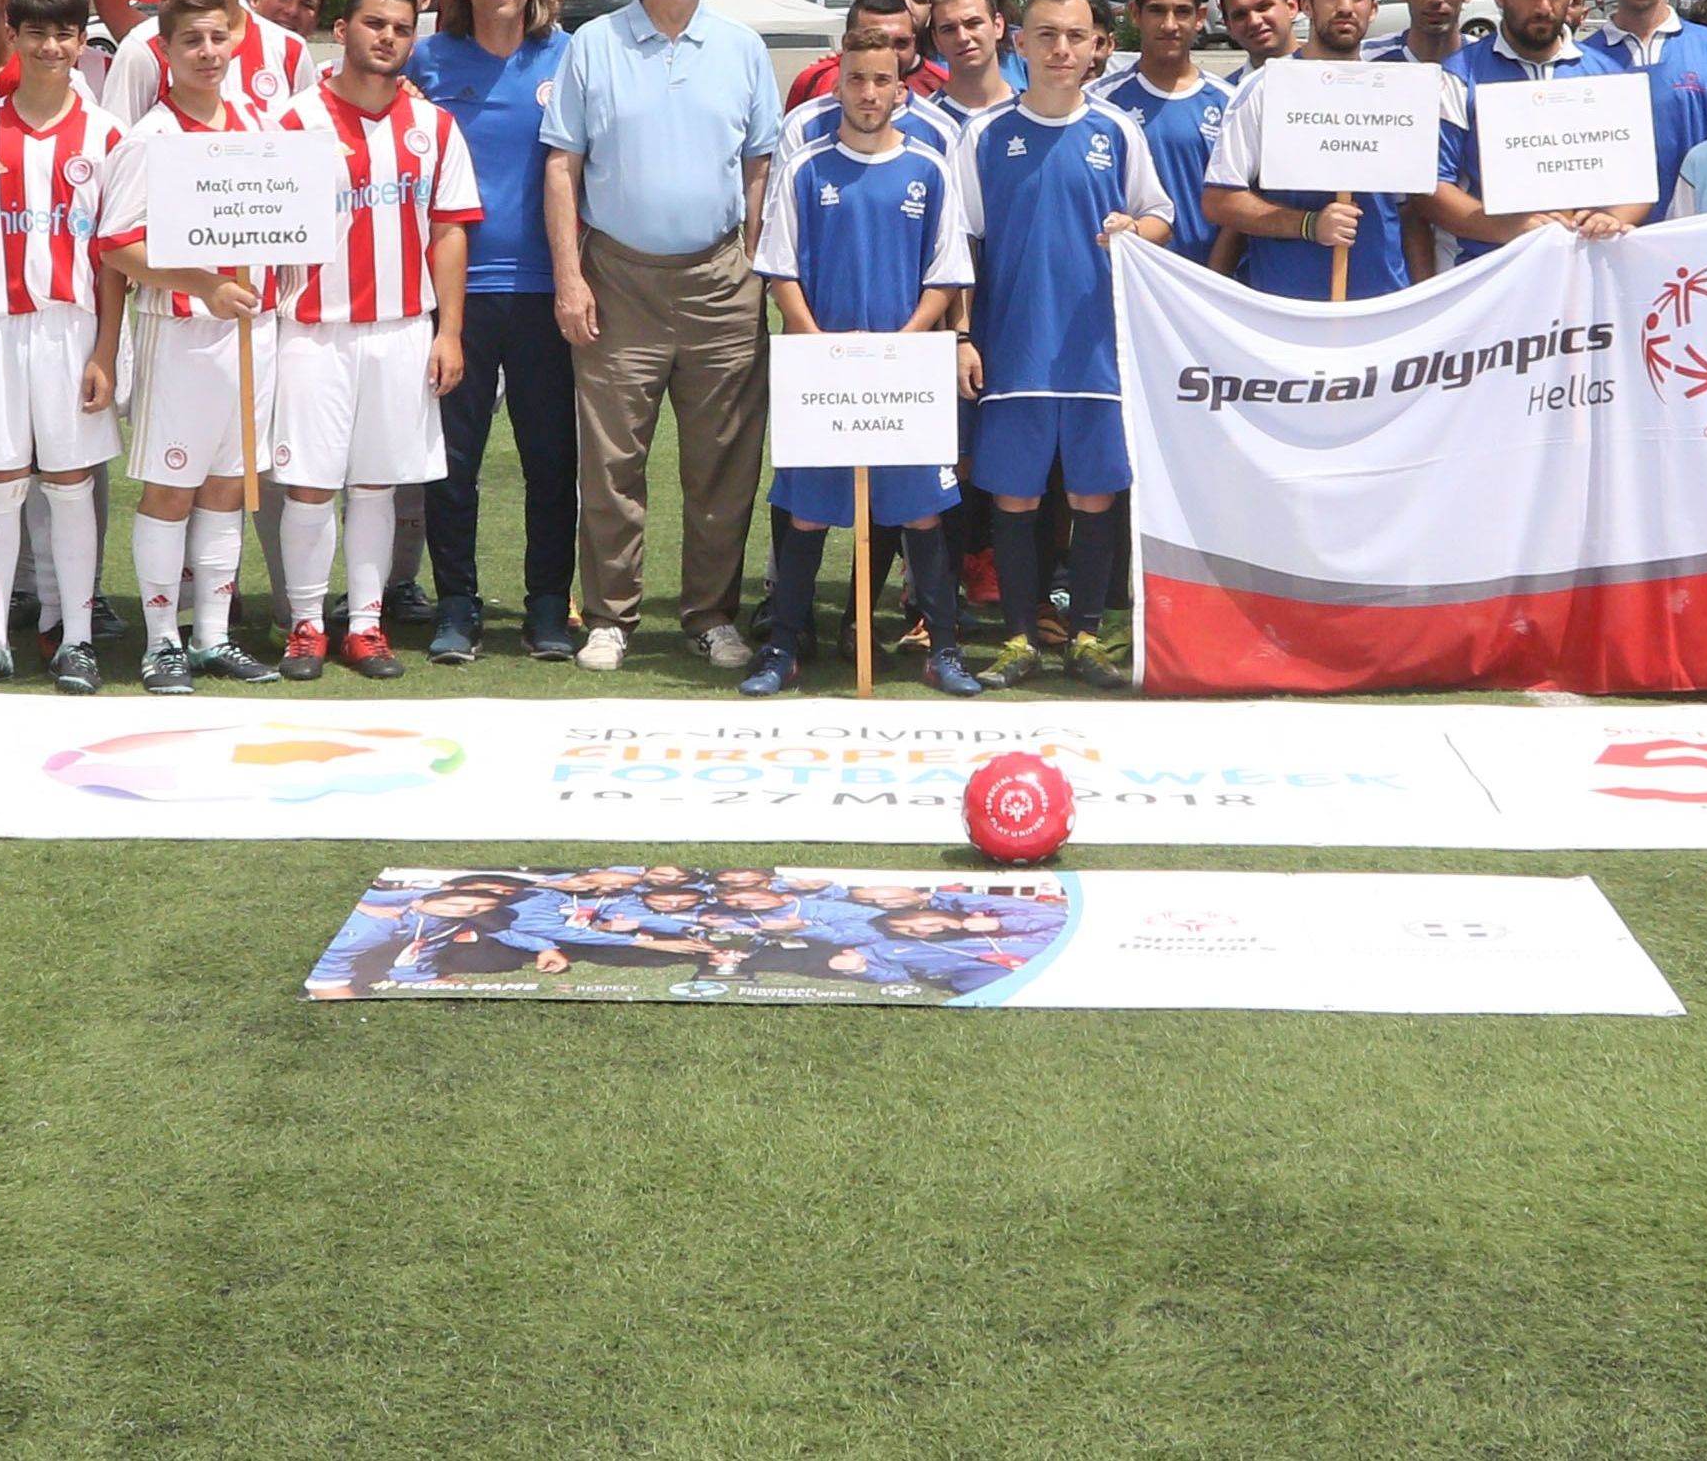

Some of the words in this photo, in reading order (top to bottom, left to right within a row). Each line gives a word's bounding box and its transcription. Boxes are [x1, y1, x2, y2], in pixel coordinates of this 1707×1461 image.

[1286, 112, 1340, 125] SPECIAL
[1344, 113, 1414, 127] OLYMPICS
[1319, 139, 1379, 153] ΑΘΗΝΑΣ
[1505, 134, 1558, 150] SPECIAL
[1561, 128, 1630, 145] OLYMPICS
[1537, 157, 1604, 174] ΠΕΡΙΣΤΕΡΙ
[196, 178, 233, 194] Μαζί
[237, 181, 262, 194] στη
[213, 202, 244, 217] μαζί
[249, 204, 282, 215] στον
[188, 225, 307, 248] Ολυμπιακό
[1175, 364, 1378, 411] Special
[1390, 319, 1615, 394] Olympics
[801, 392, 858, 406] SPECIAL
[861, 390, 935, 405] OLYMPICS
[1527, 372, 1615, 417] Hellas
[852, 416, 905, 432] ΑΧΑΪΑΣ
